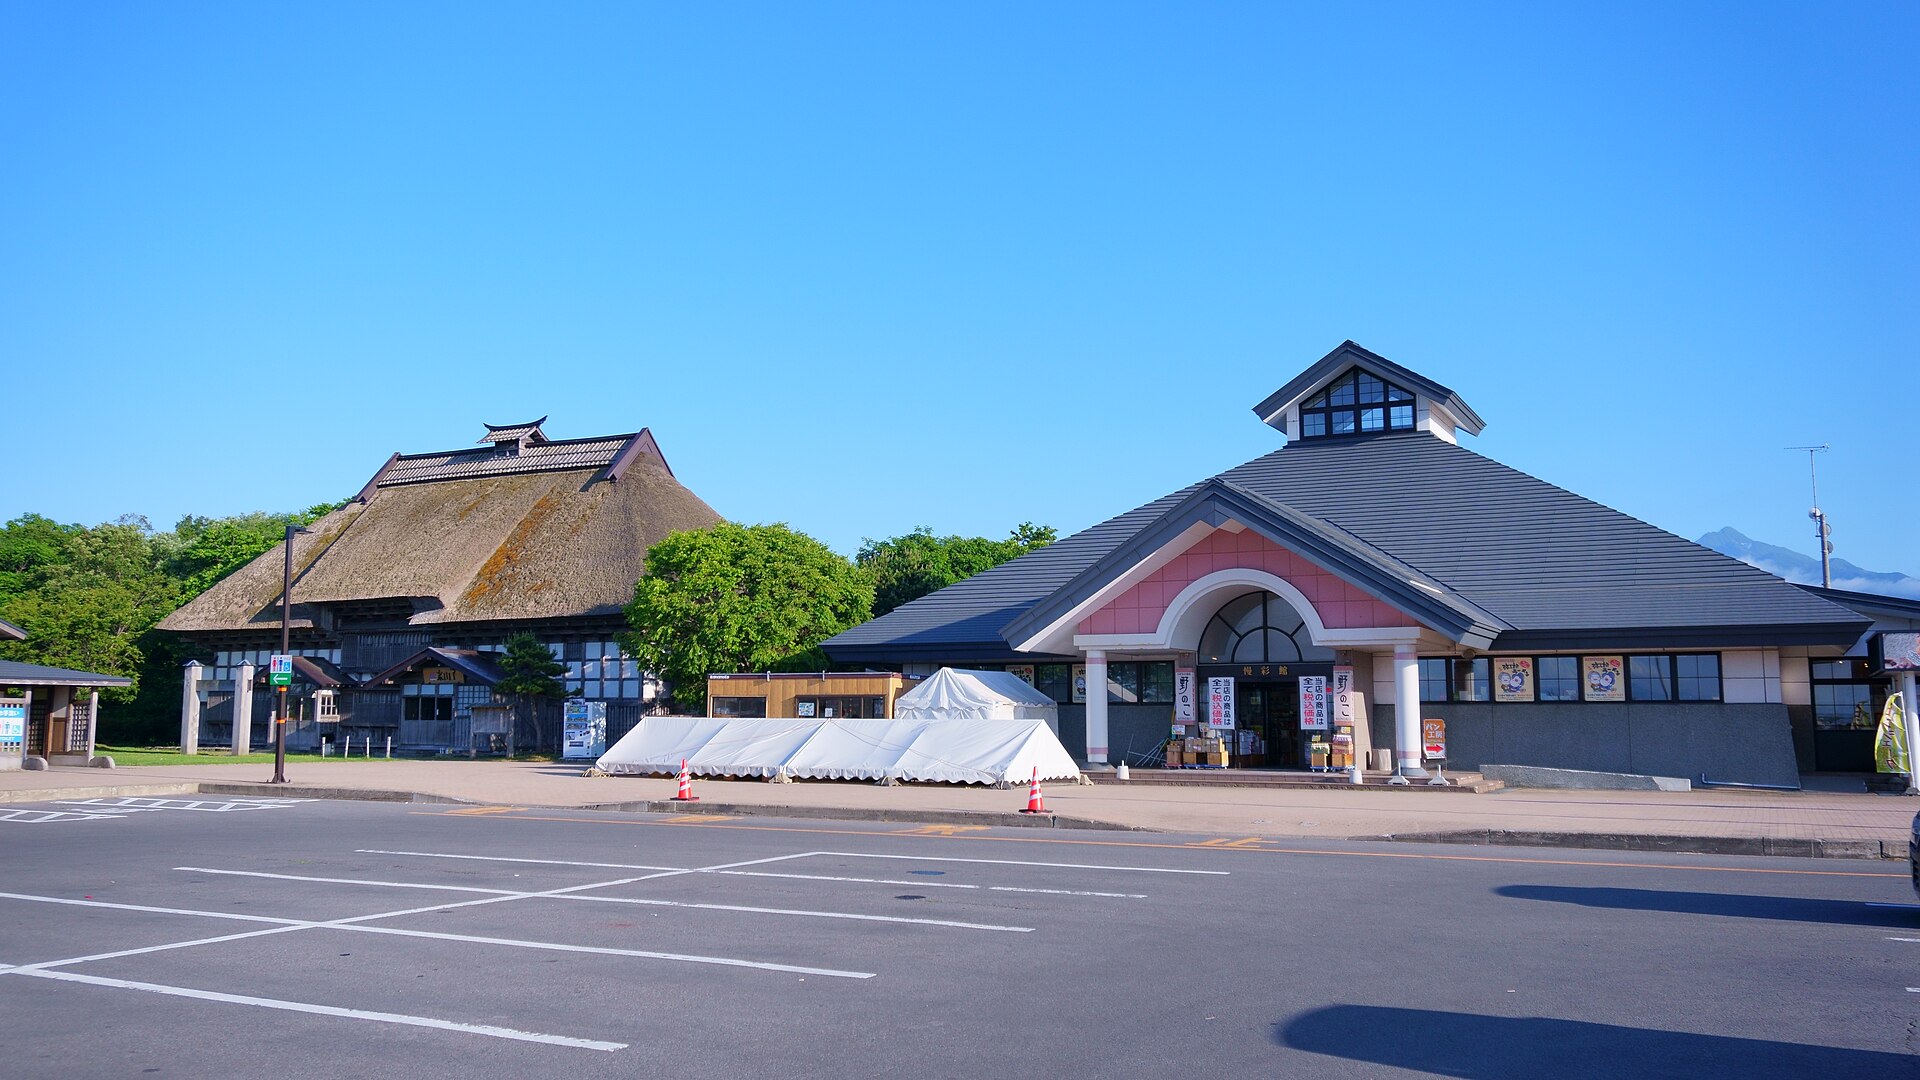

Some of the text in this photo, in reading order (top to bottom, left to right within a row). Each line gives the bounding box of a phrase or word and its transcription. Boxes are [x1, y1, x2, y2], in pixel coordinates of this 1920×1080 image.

[1212, 678, 1222, 726] 全て税込価格
[1223, 678, 1231, 726] 当店の商品は
[1303, 677, 1315, 725] 全て税込価格
[1315, 677, 1324, 725] 当店の商品は
[1425, 723, 1440, 731] パン
[1427, 731, 1443, 739] 工房
